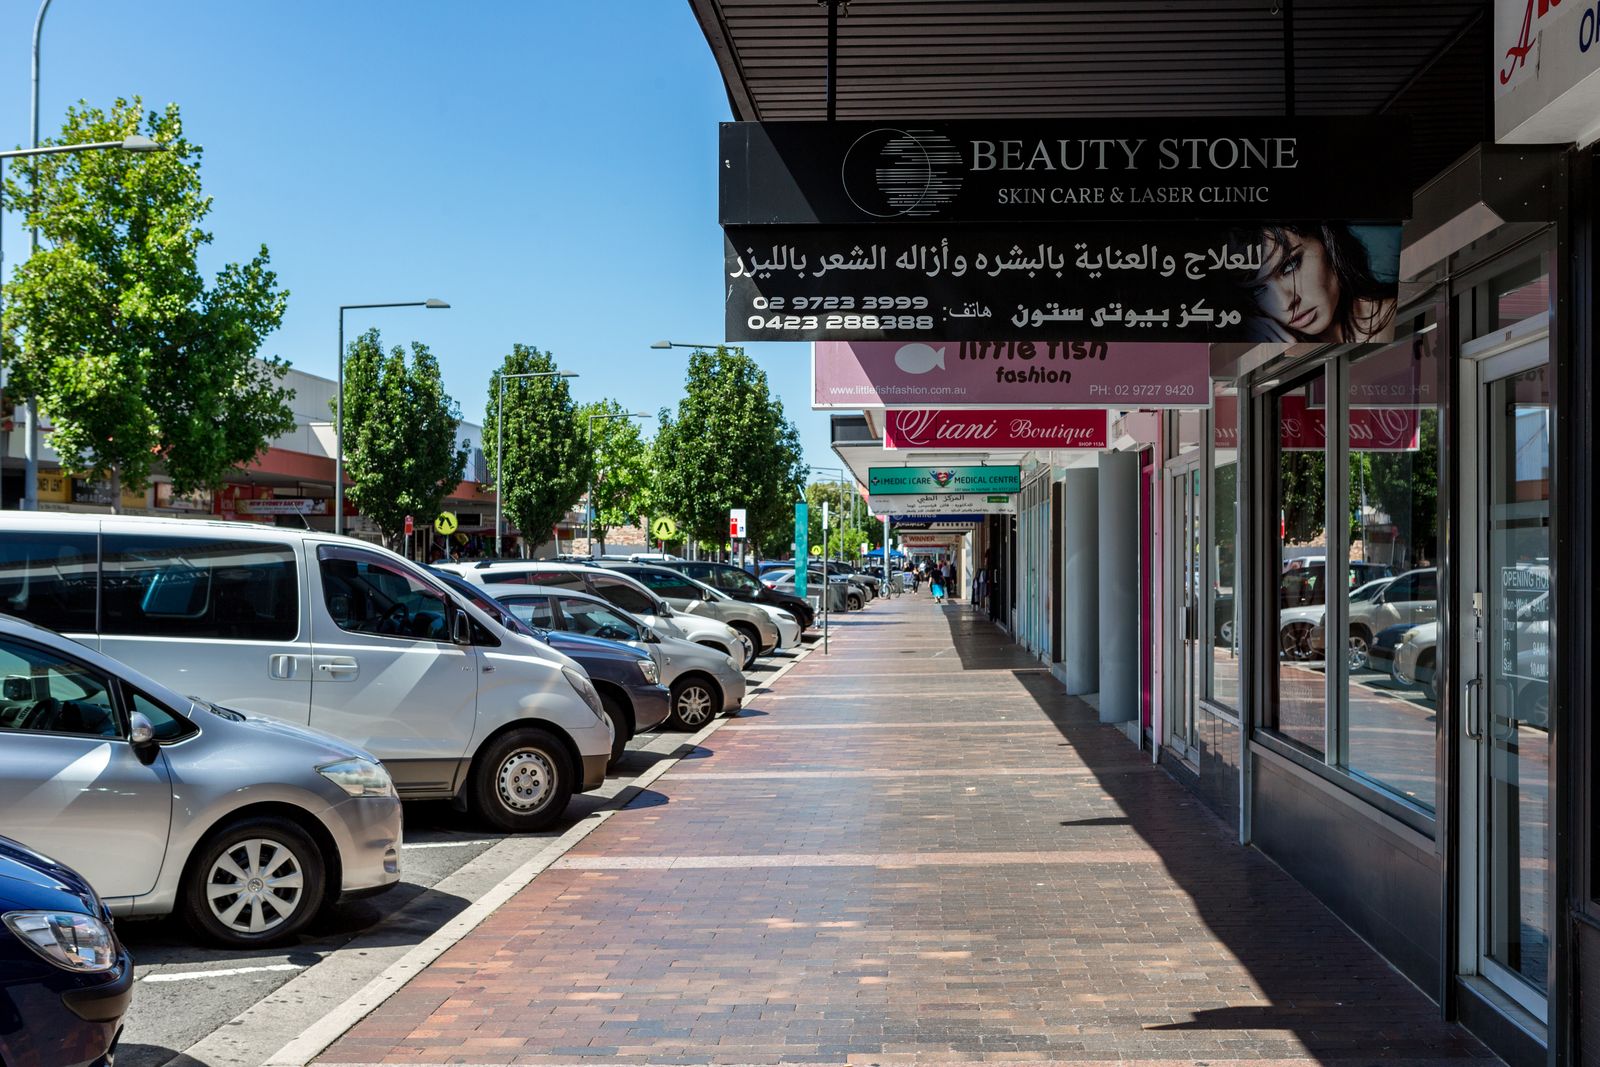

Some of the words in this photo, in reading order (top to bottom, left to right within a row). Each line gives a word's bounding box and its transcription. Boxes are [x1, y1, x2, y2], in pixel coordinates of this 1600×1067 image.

[969, 139, 1147, 171] BEAUTY
[1158, 138, 1299, 170] STONE
[998, 187, 1046, 204] SKIN
[1050, 187, 1106, 204] CARE
[1110, 187, 1125, 203] &
[1130, 187, 1195, 203] LASER
[1199, 186, 1270, 203] CLINIC
[730, 244, 807, 279] بالليزر
[813, 244, 887, 278] الشعر
[975, 244, 1065, 279] بالبشره
[1074, 242, 1176, 279] والعناية
[1184, 243, 1263, 280] للعلاج
[752, 296, 785, 310] 02
[792, 296, 856, 310] 9723
[862, 296, 929, 310] 3999
[942, 301, 992, 322] هاتف:
[1176, 298, 1242, 328] مركز
[747, 315, 819, 330] 0423
[825, 315, 934, 330] 288388
[1010, 302, 1084, 328] ستون
[995, 365, 1072, 384] fashion
[829, 385, 967, 396] www.littlefishfashion.com.au
[1089, 384, 1111, 396] PH:
[1114, 384, 1129, 396] 02
[1132, 384, 1162, 396] 9727
[1165, 384, 1195, 396] 9420
[896, 409, 998, 445] Viani
[1009, 418, 1095, 445] Boutique
[954, 475, 986, 485] MEDICAL
[989, 475, 1019, 484] CENTRE
[1503, 571, 1534, 586] OPENING
